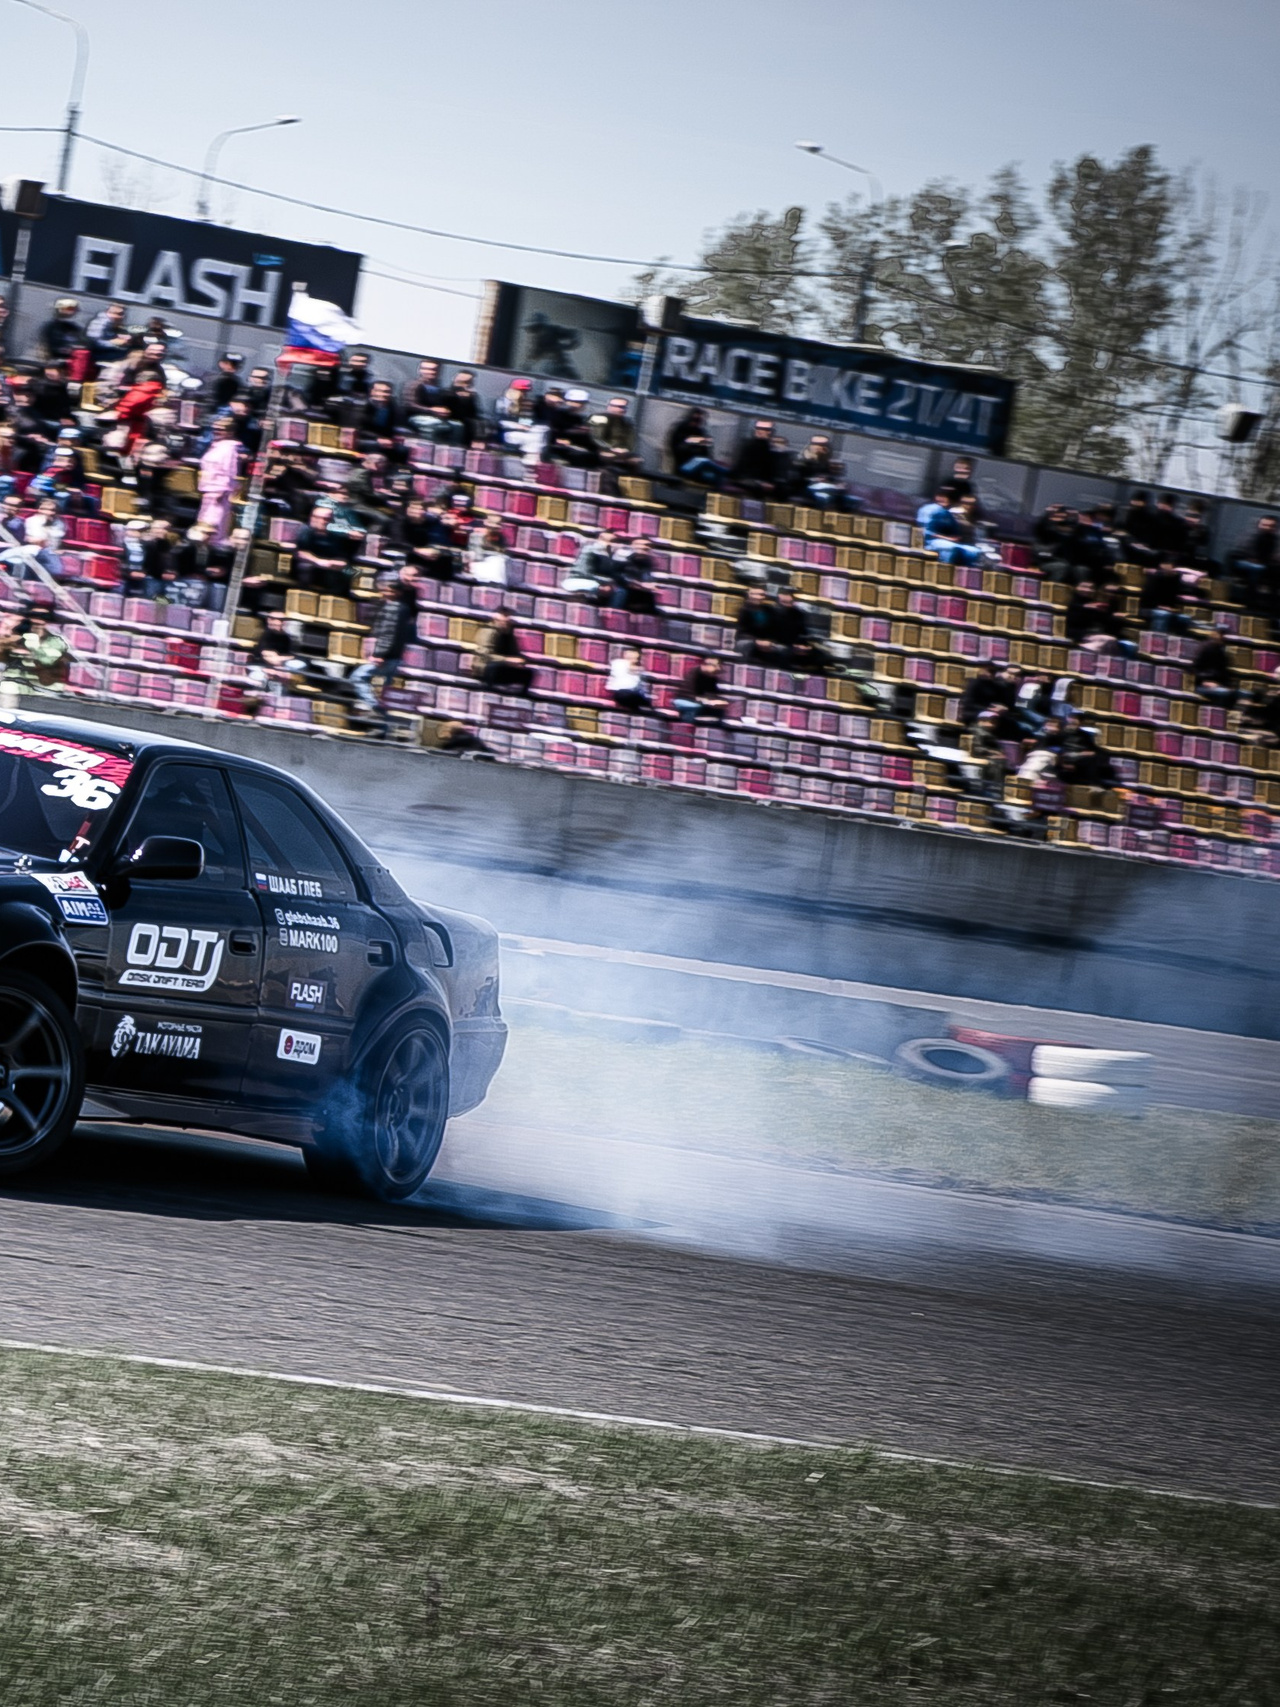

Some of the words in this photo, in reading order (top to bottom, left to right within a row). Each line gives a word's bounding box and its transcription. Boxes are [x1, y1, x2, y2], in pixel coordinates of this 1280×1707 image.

[71, 234, 283, 327] FLASH
[662, 336, 780, 396] RACE
[783, 358, 885, 416] BIKE
[40, 768, 122, 810] 36
[268, 875, 297, 895] ШААБ
[298, 880, 322, 898] ГЛЕБ
[289, 929, 338, 953] MARK100
[290, 982, 323, 1004] FLASH
